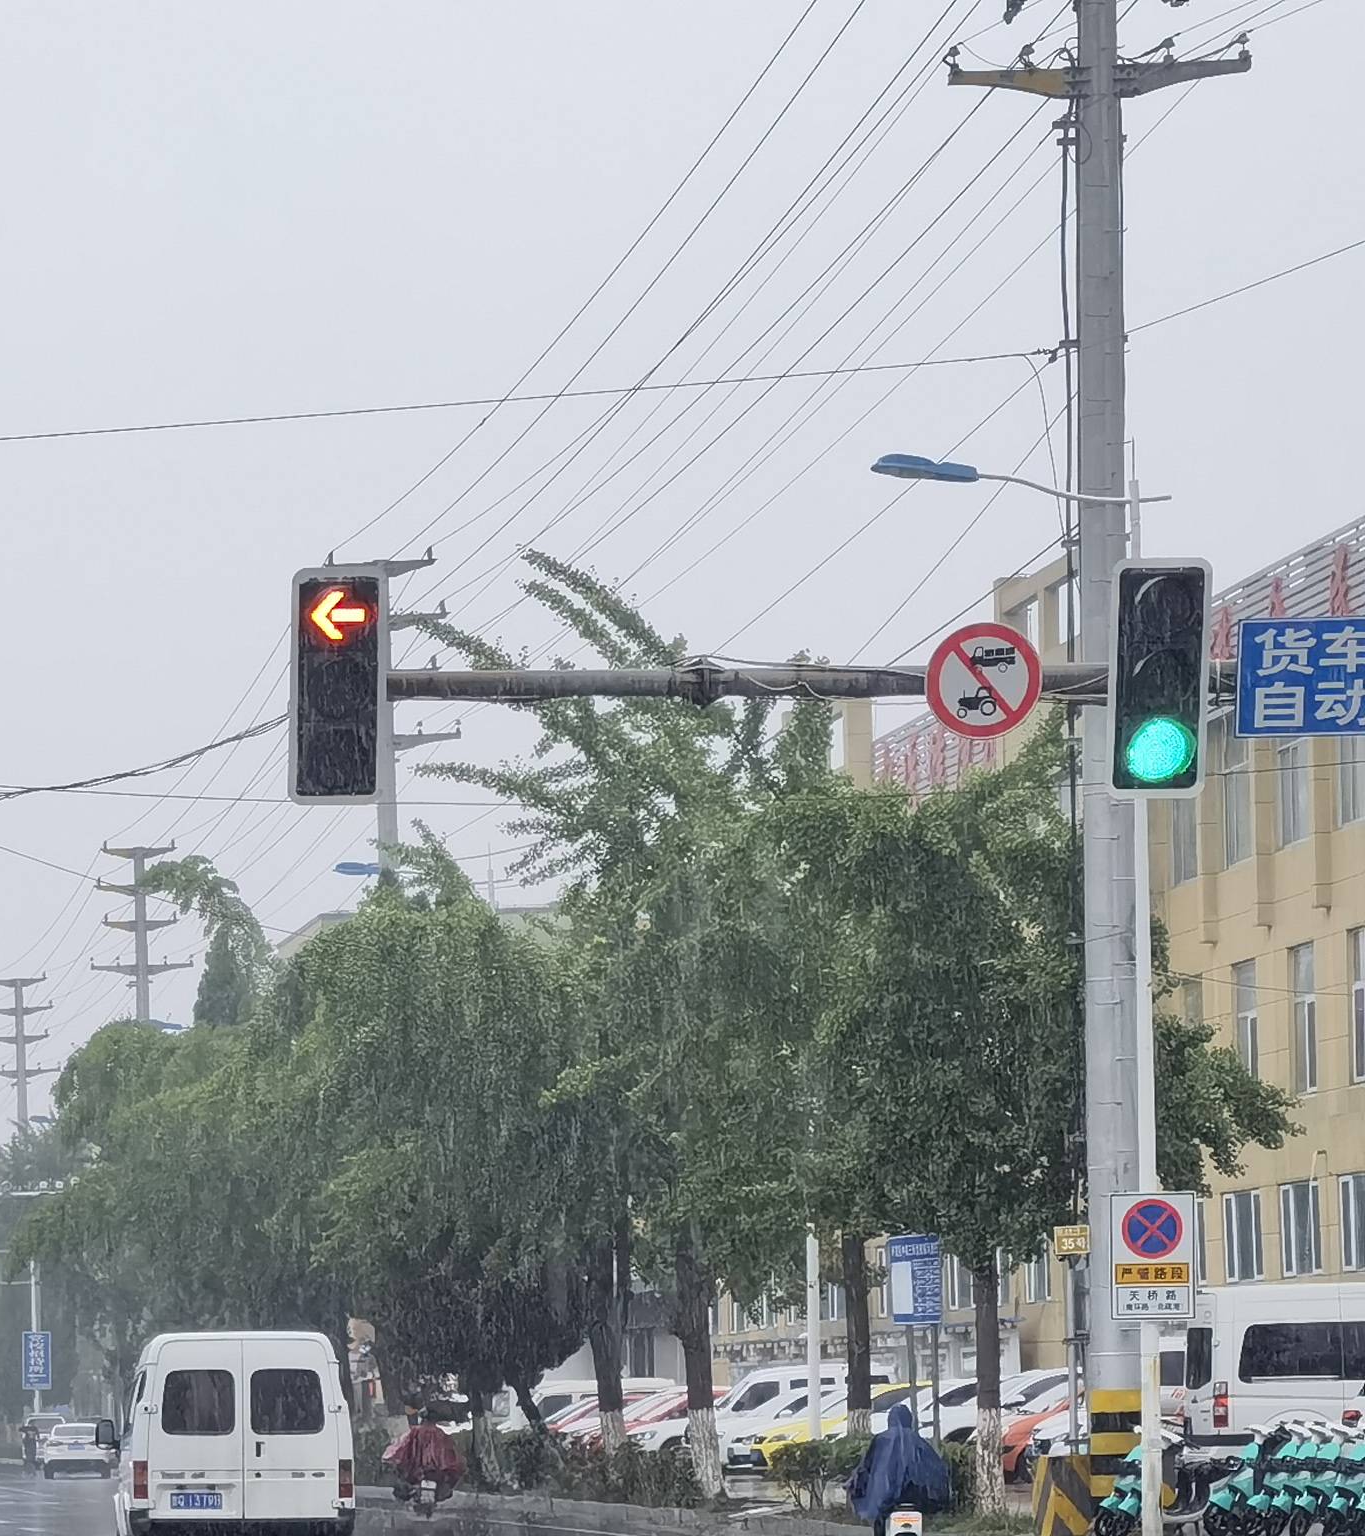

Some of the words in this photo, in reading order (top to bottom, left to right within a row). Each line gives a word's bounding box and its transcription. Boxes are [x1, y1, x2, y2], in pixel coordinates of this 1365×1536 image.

[1254, 626, 1365, 677] 货车
[1254, 679, 1365, 729] 自动
[1121, 1266, 1183, 1280] 严管路段
[1129, 1290, 1177, 1301] 天桥路
